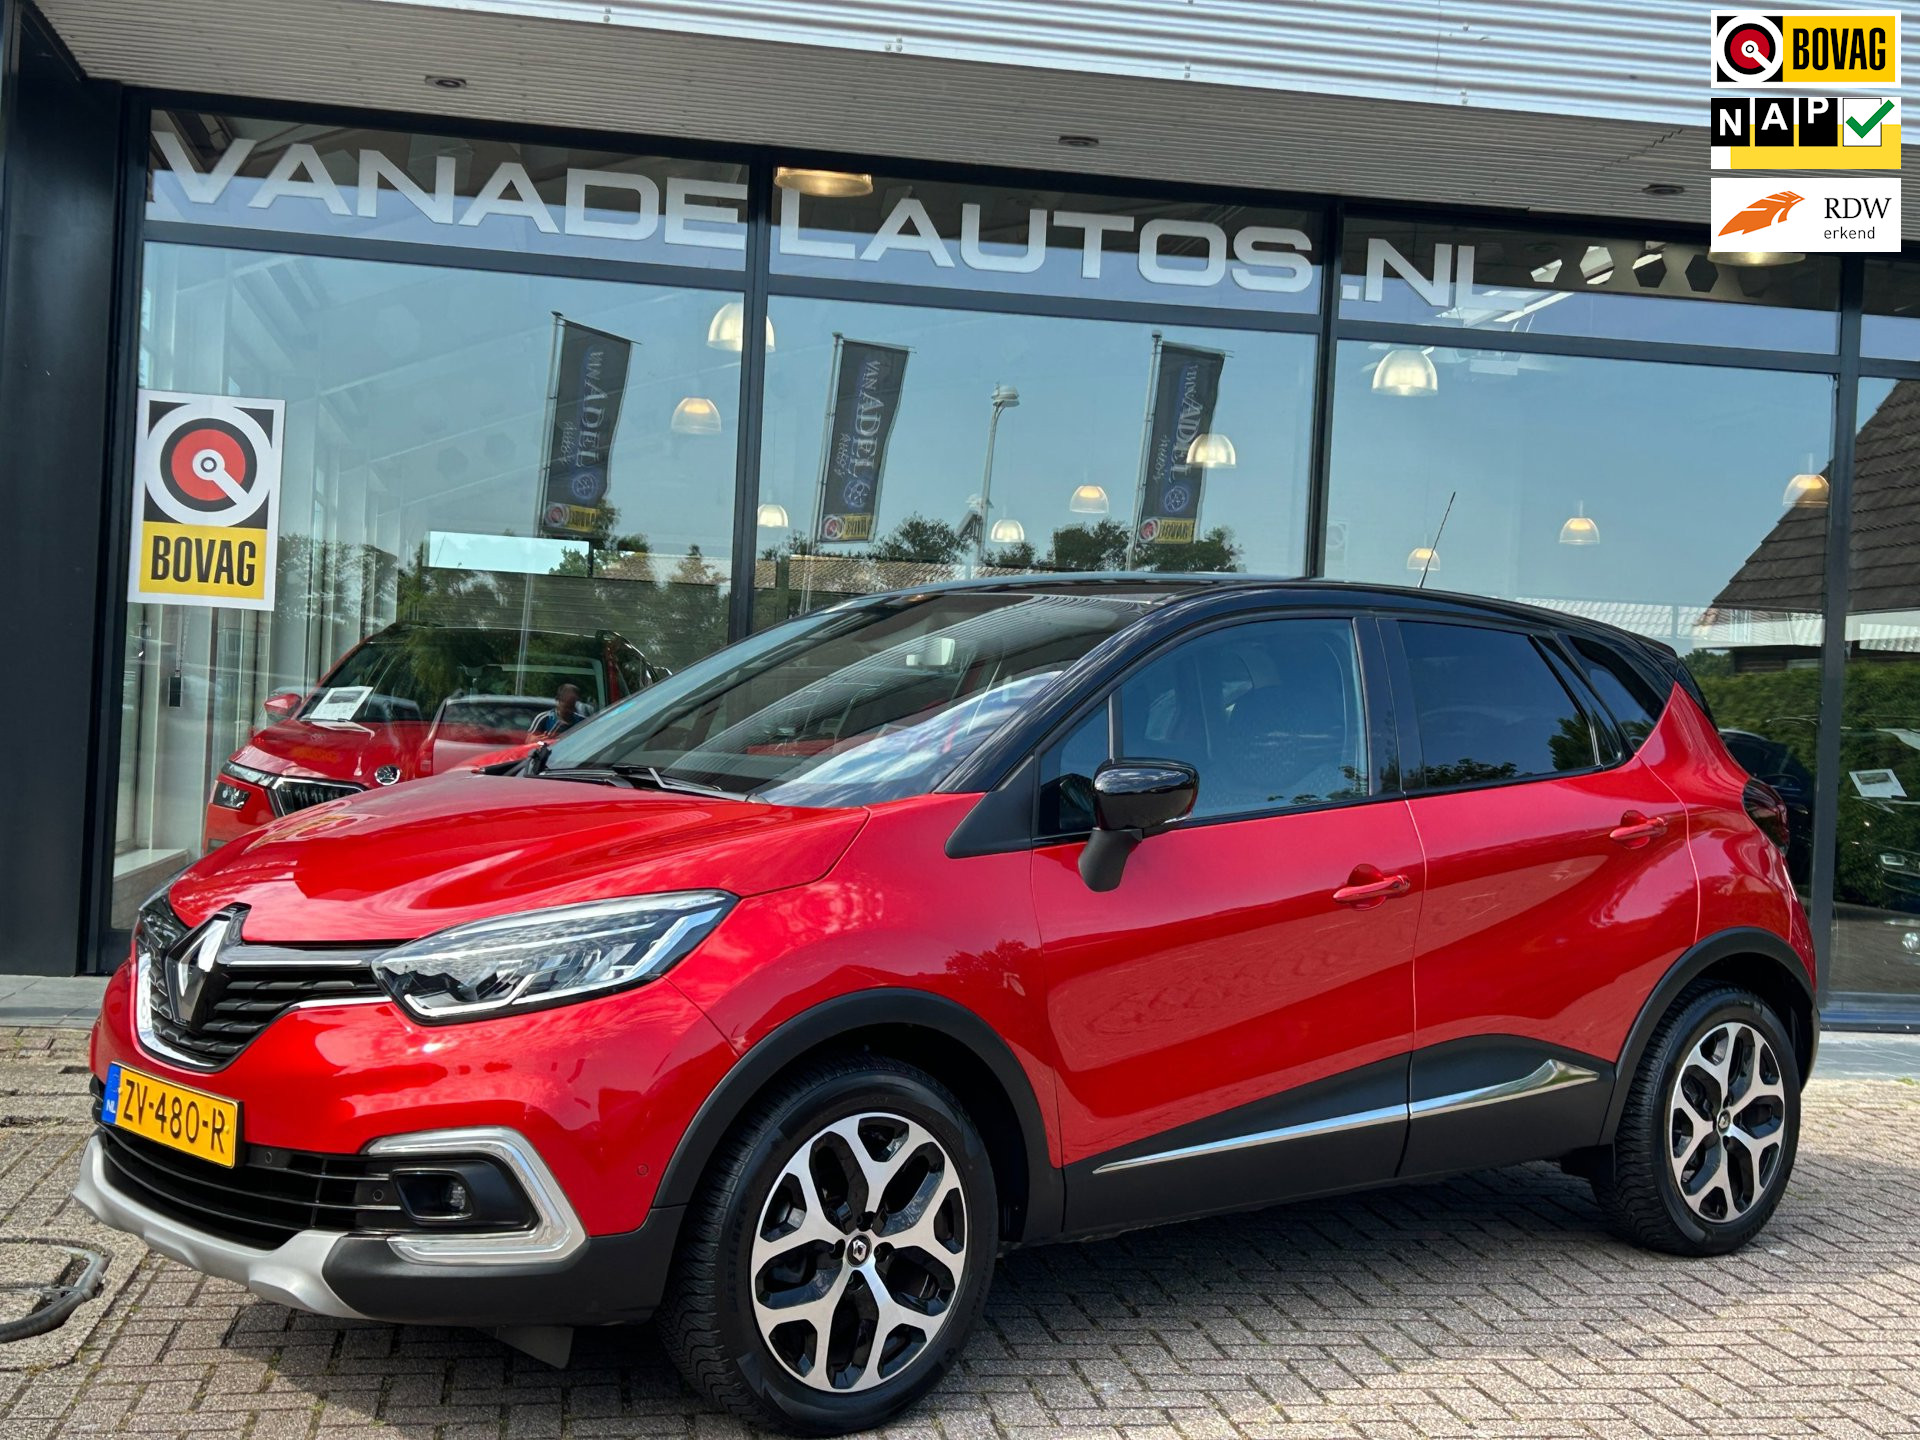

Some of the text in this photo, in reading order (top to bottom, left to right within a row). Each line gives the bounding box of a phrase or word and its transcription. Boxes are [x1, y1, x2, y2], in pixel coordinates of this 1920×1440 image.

[576, 378, 607, 468] ADEL
[848, 360, 885, 479] VAN ADEL
[151, 535, 257, 586] BOVAG
[106, 1099, 117, 1114] NL
[123, 1078, 226, 1154] ZV-480-R
